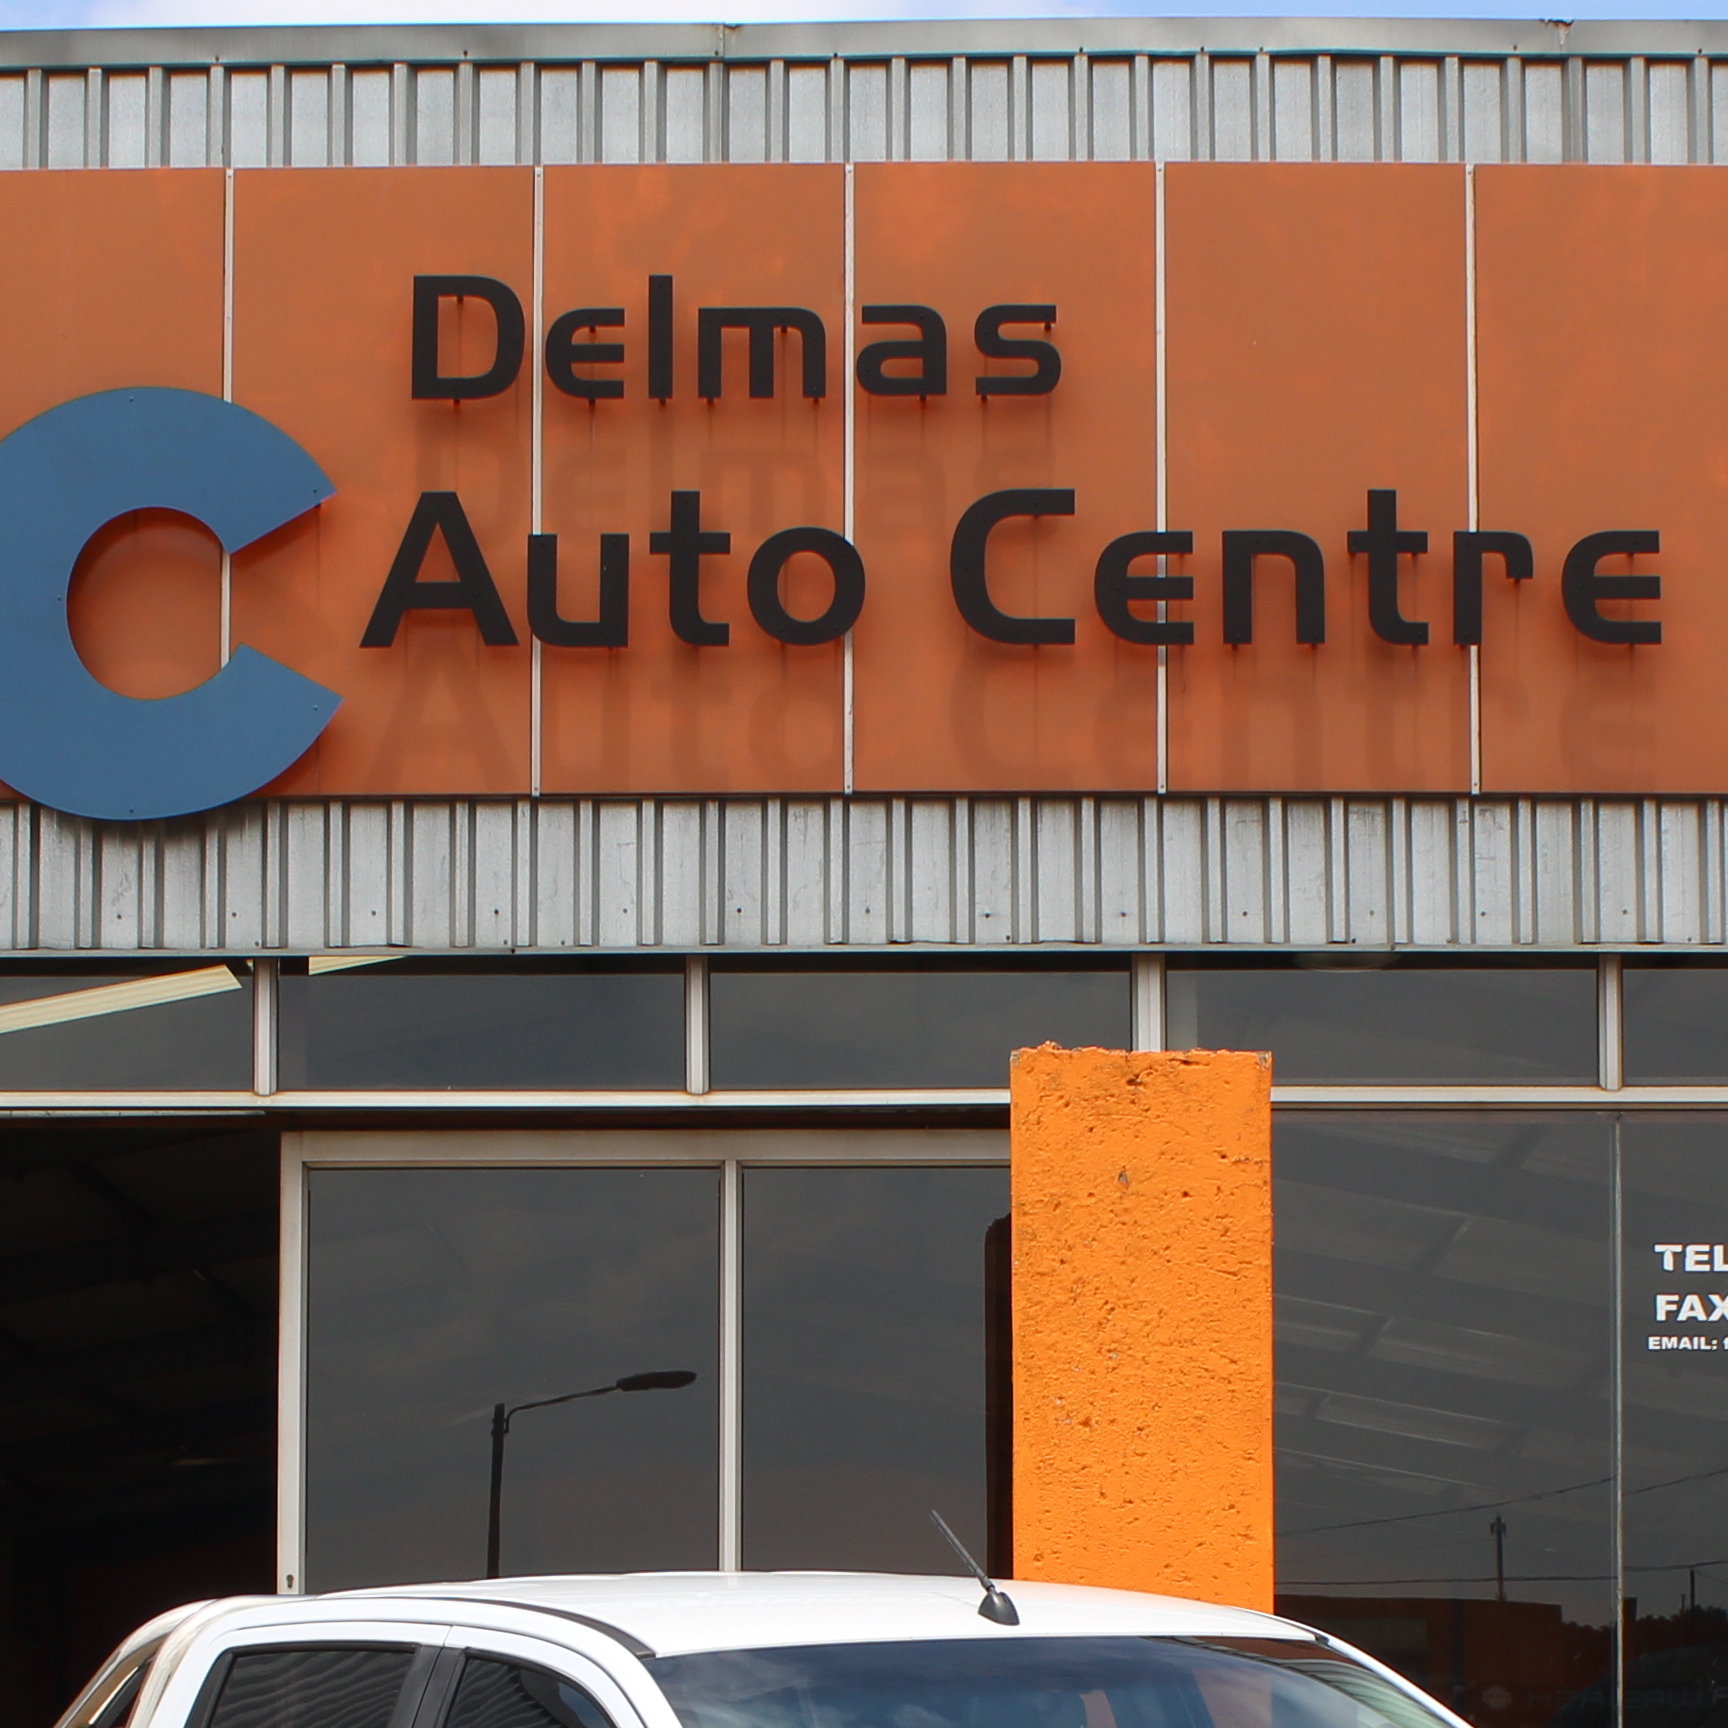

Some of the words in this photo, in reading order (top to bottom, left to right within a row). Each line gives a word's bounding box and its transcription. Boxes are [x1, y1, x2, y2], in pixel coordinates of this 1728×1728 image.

[411, 274, 1062, 399] Delmas
[358, 490, 866, 648] Auto
[949, 488, 1662, 646] Centre
[1647, 1336, 1718, 1351] EMAIL:
